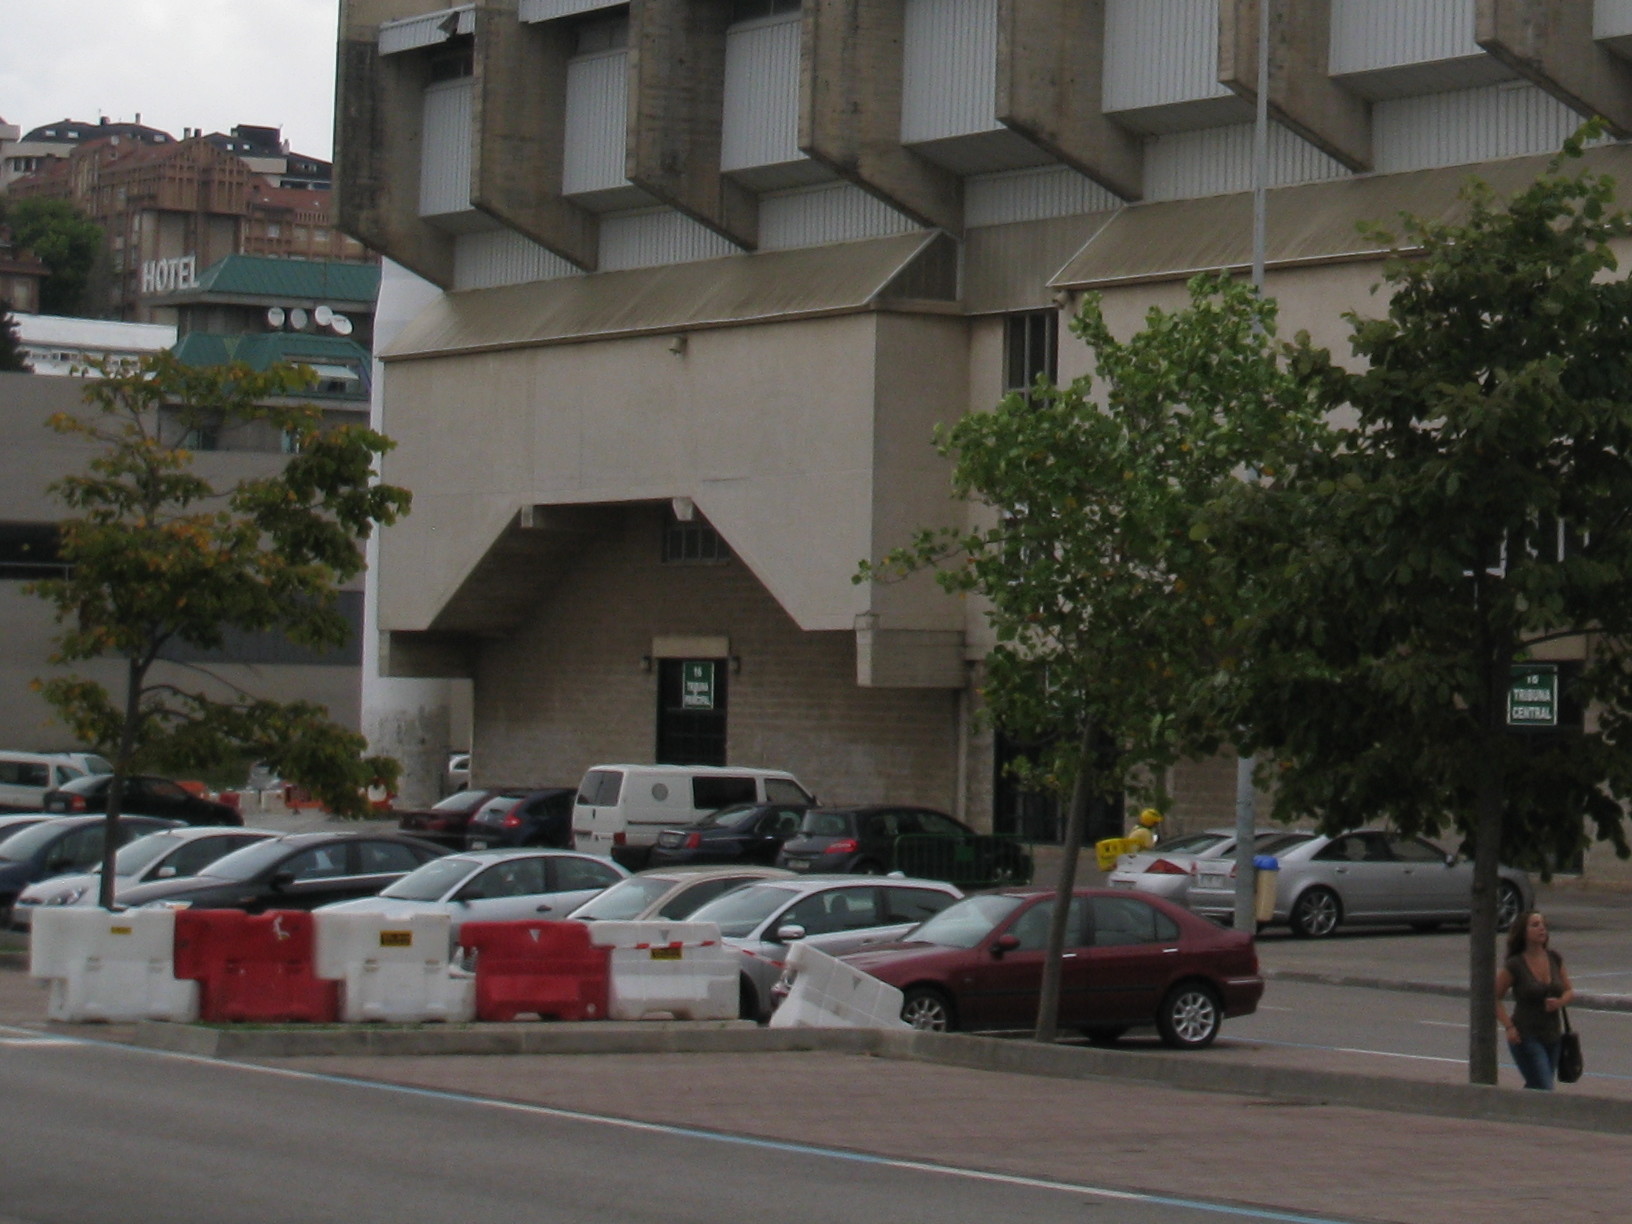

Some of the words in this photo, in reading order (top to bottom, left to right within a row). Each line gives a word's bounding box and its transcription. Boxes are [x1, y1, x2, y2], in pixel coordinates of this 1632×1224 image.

[141, 255, 200, 293] HOTEL
[1513, 688, 1551, 701] TRIBUNA
[1512, 706, 1552, 720] CENTRAL
